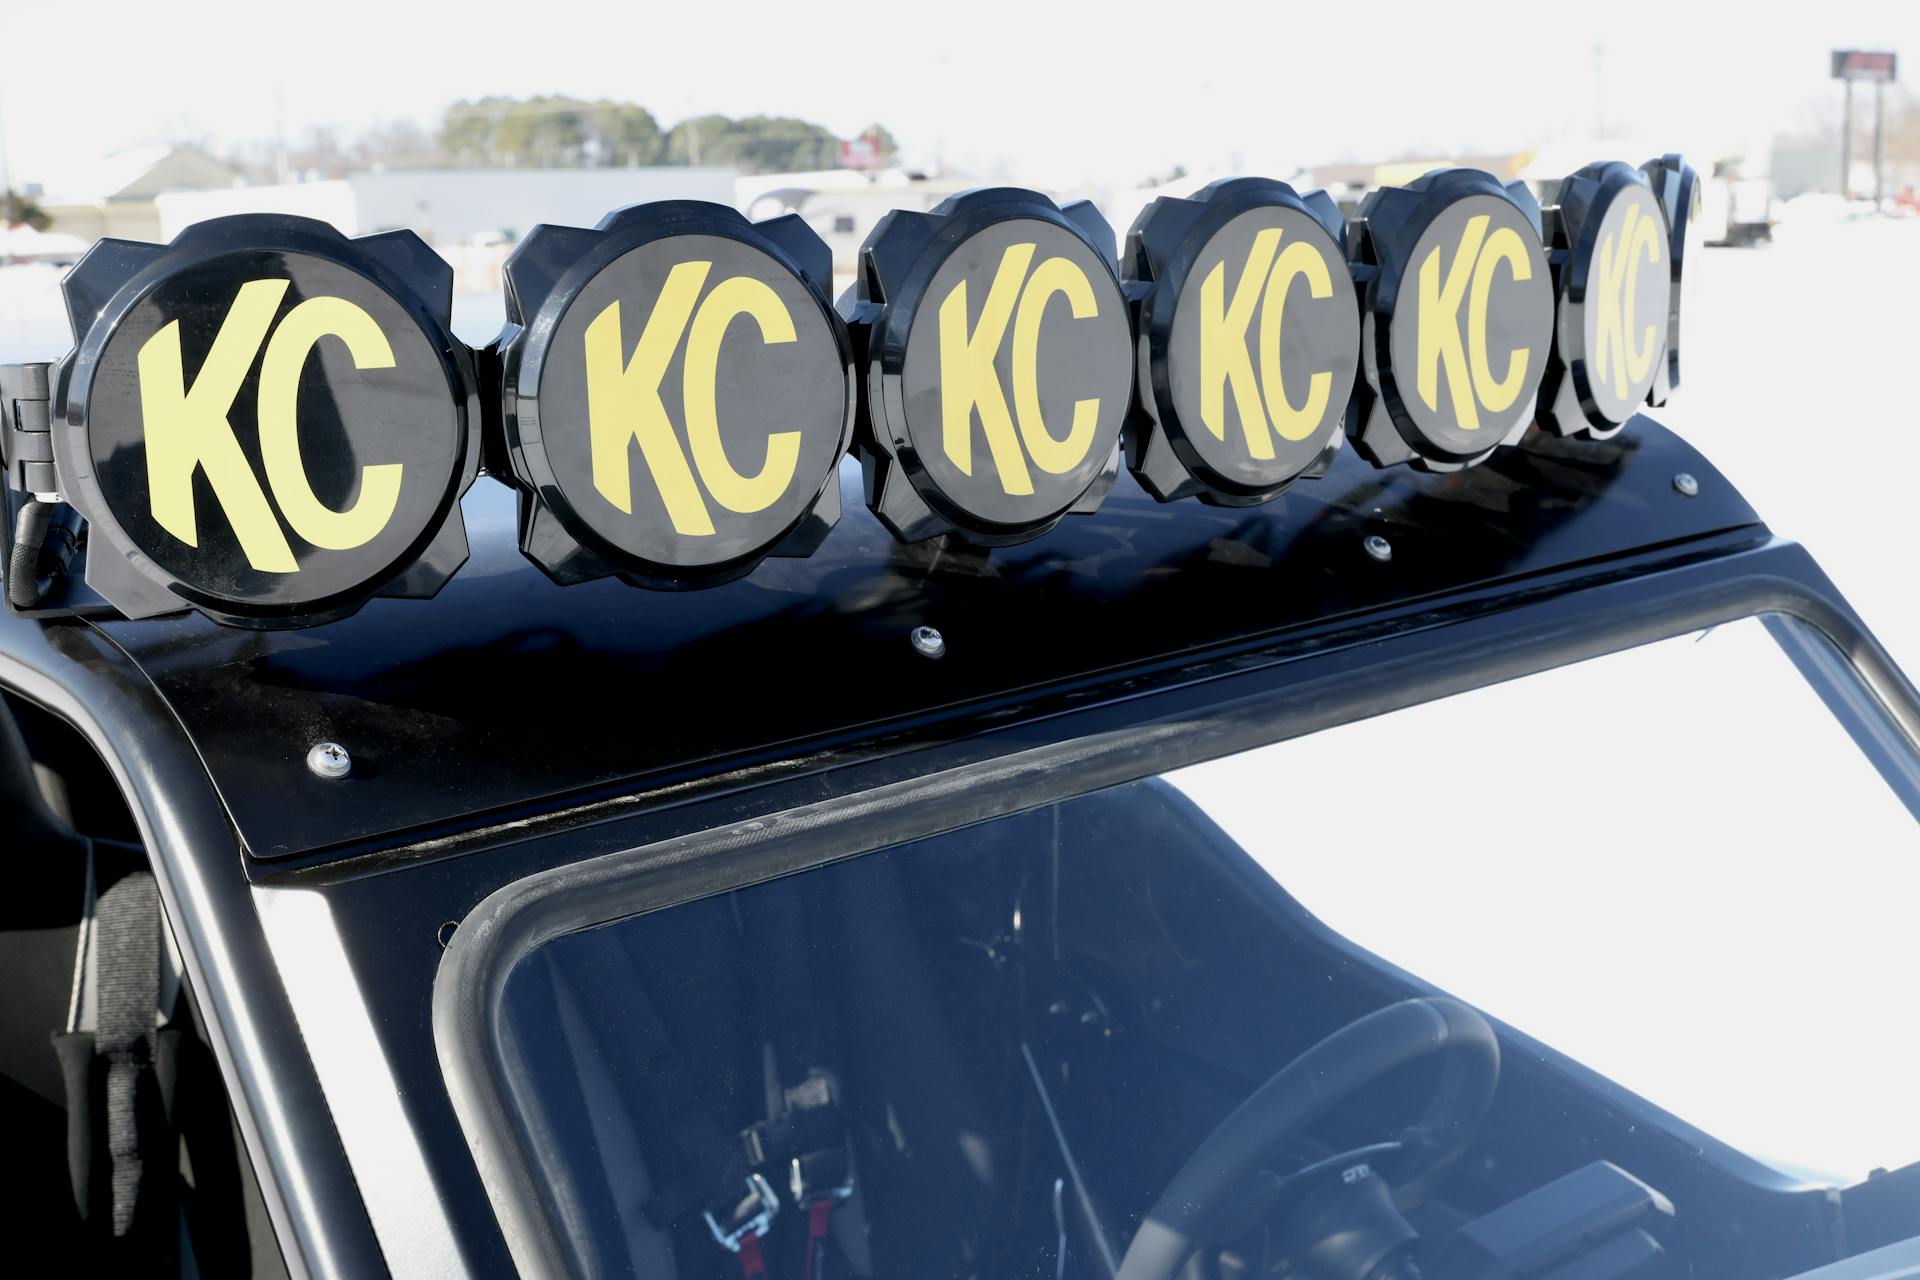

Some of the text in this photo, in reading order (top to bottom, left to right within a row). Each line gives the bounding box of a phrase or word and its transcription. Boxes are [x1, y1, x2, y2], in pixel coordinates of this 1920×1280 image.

[584, 260, 802, 536] KC
[938, 242, 1100, 496] KC
[1200, 227, 1333, 460] KC
[1416, 215, 1532, 430] KC
[1596, 203, 1660, 400] KC
[138, 279, 403, 572] KC
